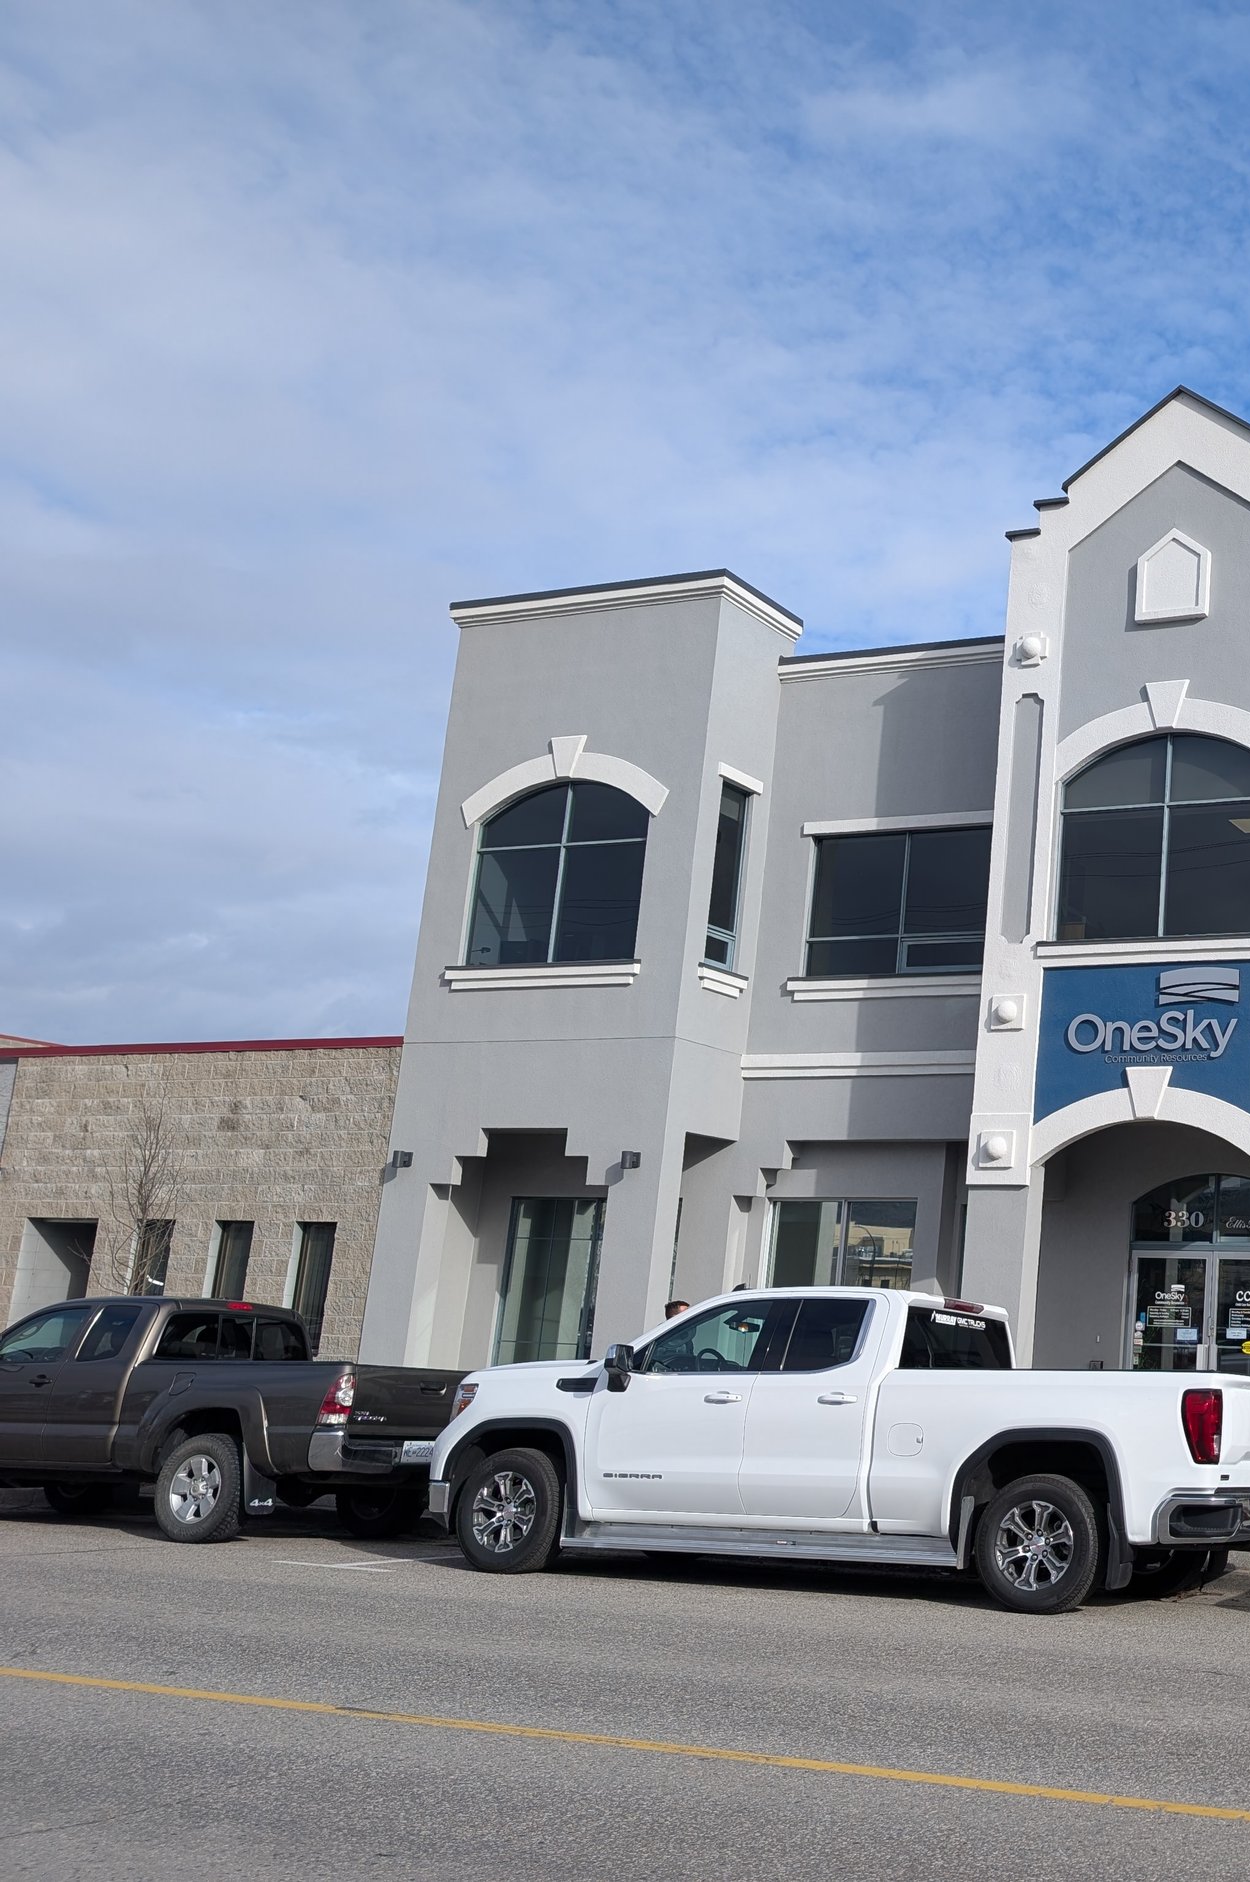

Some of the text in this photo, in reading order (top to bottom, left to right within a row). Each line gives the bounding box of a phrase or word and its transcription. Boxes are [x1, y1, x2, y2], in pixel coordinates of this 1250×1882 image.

[1067, 1009, 1239, 1058] OneSky
[1104, 1052, 1208, 1064] Community Resources
[1163, 1211, 1204, 1228] 330
[1225, 1216, 1246, 1229] Ellis
[1155, 1291, 1185, 1301] OneSky
